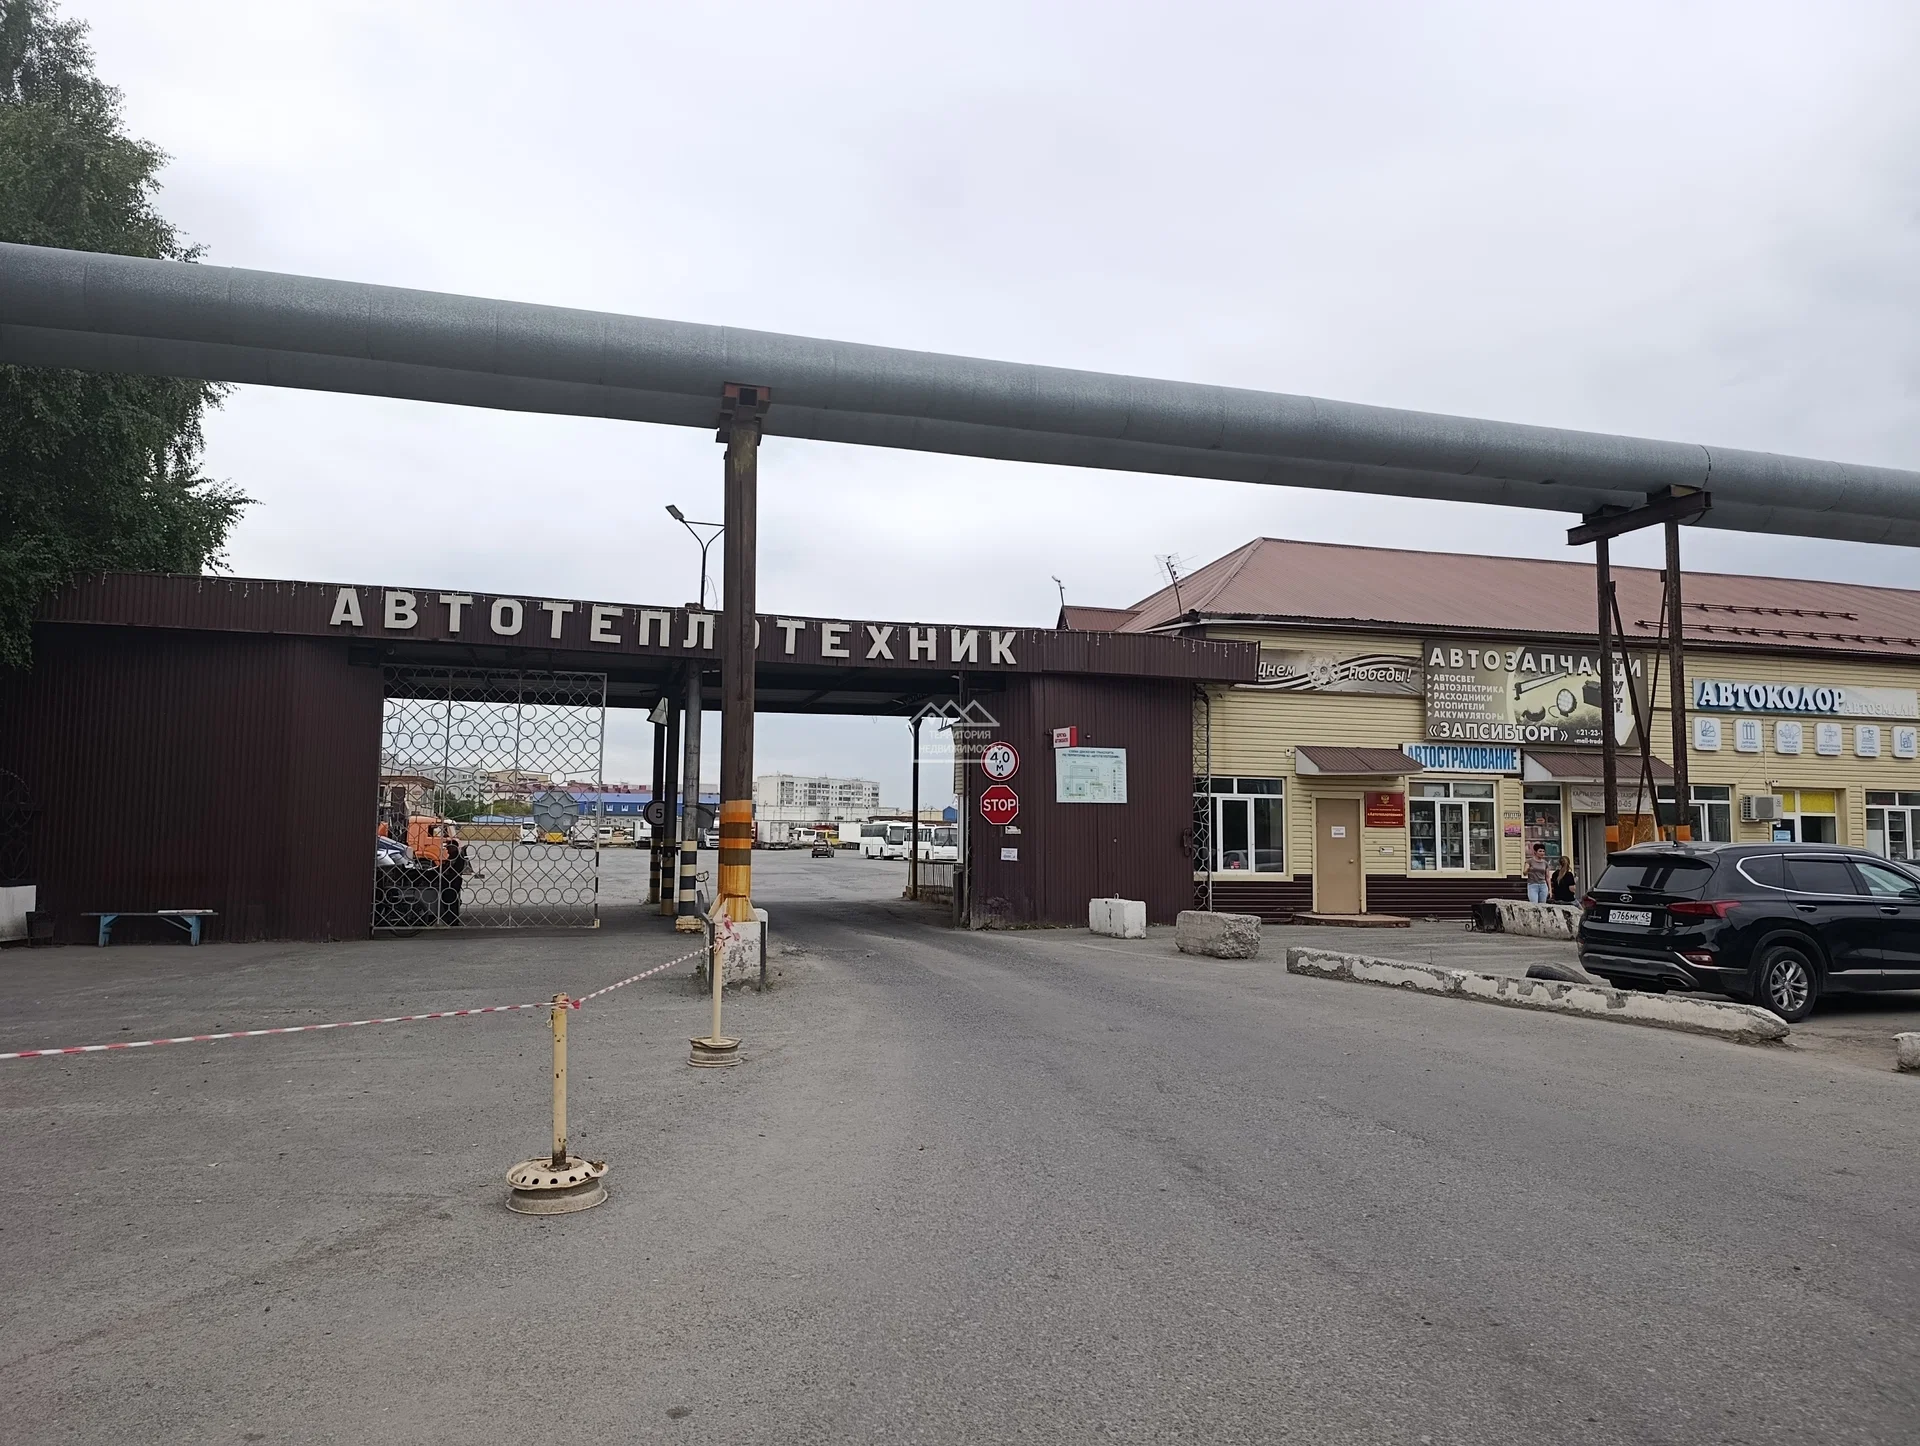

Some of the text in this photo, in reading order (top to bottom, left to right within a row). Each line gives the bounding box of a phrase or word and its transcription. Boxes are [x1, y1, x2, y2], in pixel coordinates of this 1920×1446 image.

[330, 587, 1017, 665] АВТОТЕПЛТЕХНИК
[1428, 647, 1641, 677] АВТОЗАПЧАТИ
[1348, 665, 1412, 683] Победы!
[1433, 673, 1475, 683] АВТОСВЕТ
[1433, 683, 1505, 694] АВТОЭЛЕКТРИКА
[1433, 692, 1493, 702] РАСХОДНИКИ
[1698, 681, 1847, 713] АВТОКОЛОР
[1433, 701, 1485, 711] ОТОПИТЕЛИ
[1433, 710, 1504, 721] АККУМУЛЯТОРЫ
[1428, 721, 1569, 742] «ЗАПСИБТОРГ»
[990, 751, 1010, 764] 4,0
[1407, 745, 1518, 770] АВТОСТРАХОВАНИЕ
[996, 764, 1004, 772] М
[983, 798, 1017, 812] STOP
[655, 808, 663, 819] 5
